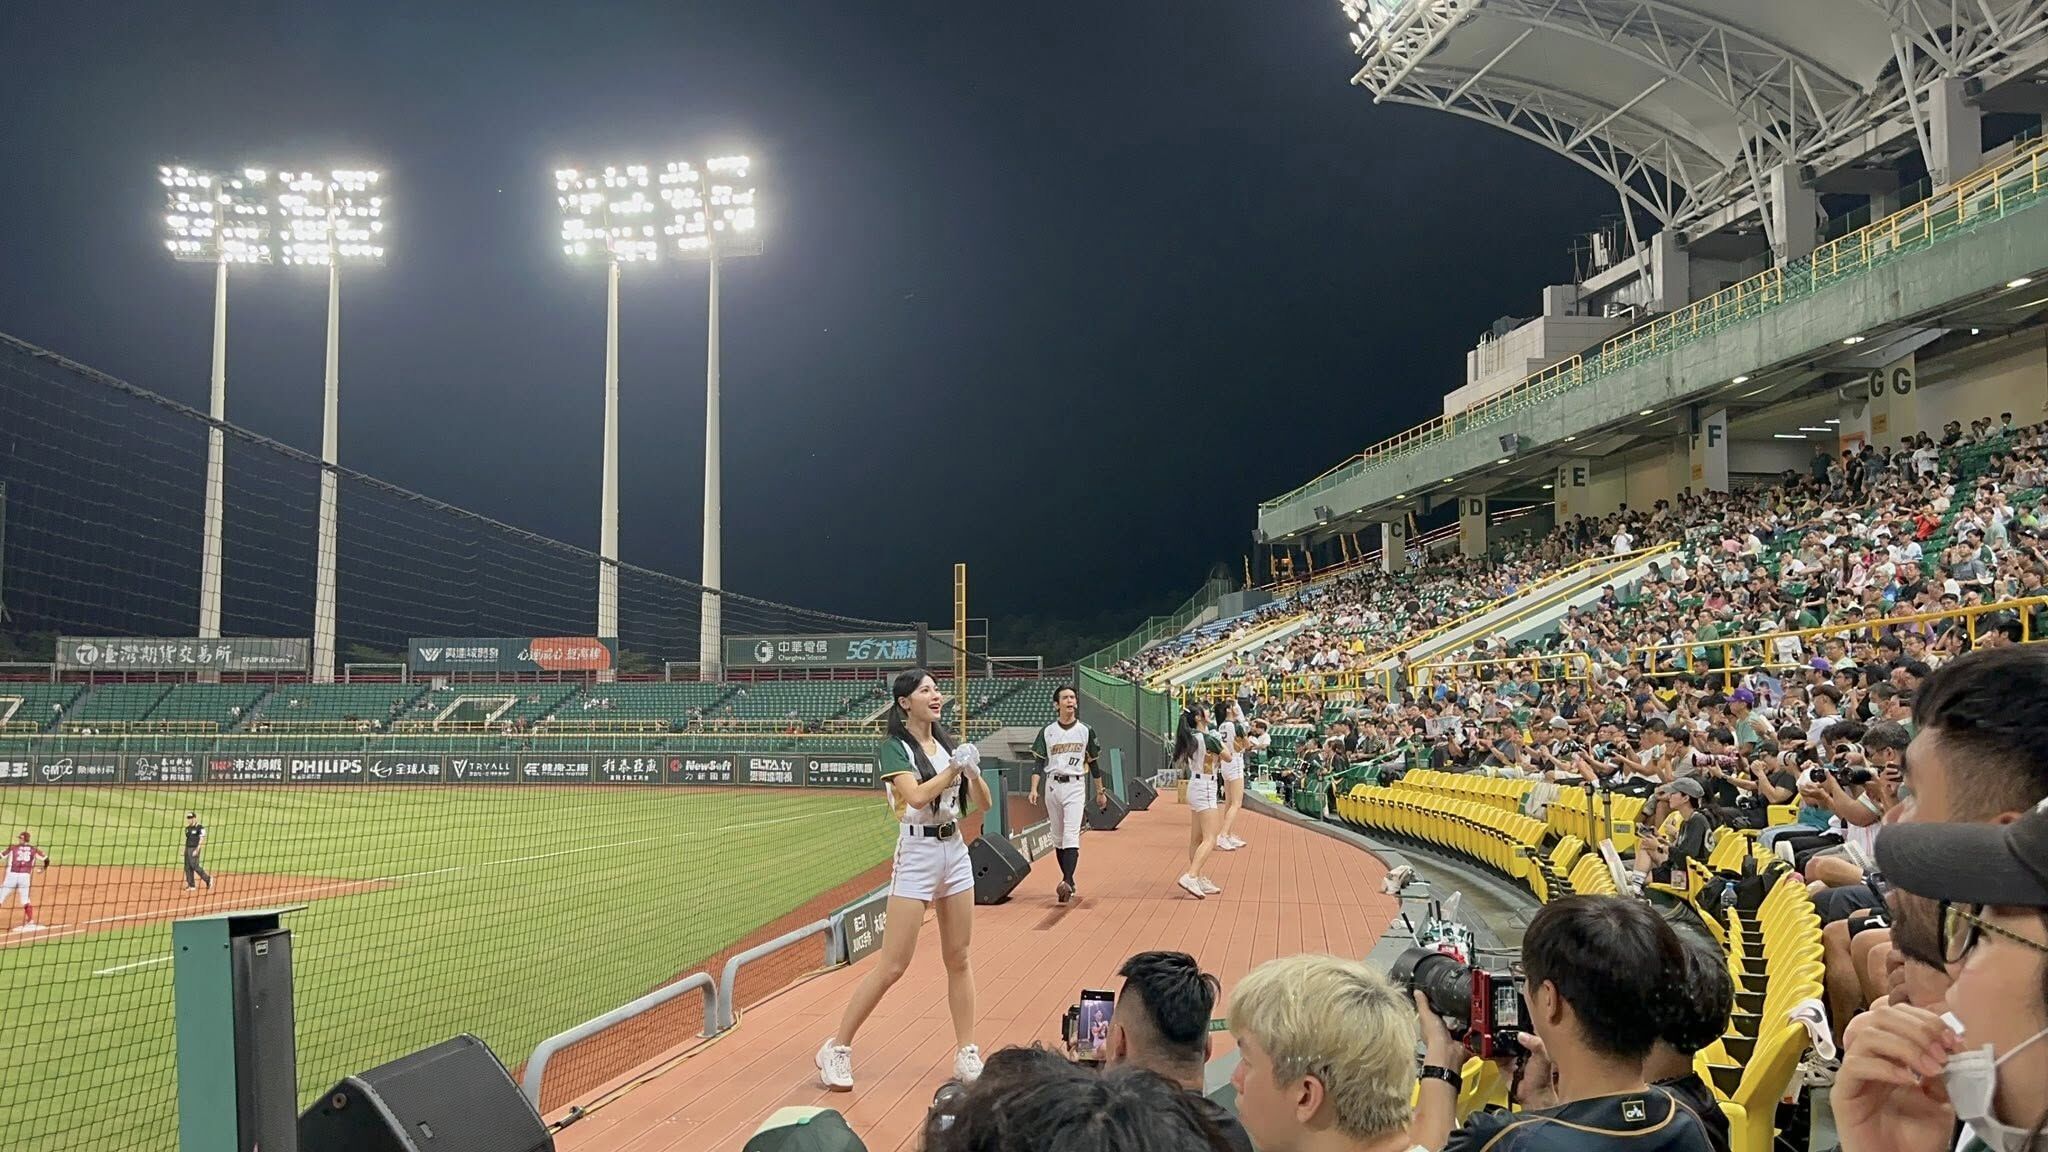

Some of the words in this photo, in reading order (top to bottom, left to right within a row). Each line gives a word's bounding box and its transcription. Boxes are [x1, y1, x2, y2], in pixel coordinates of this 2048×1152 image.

[1871, 367, 1884, 397] G
[1893, 367, 1911, 395] G
[1708, 425, 1722, 447] F
[1560, 469, 1566, 488] E
[1573, 467, 1585, 486] E
[1470, 499, 1483, 516] D
[1391, 522, 1402, 538] C
[101, 643, 232, 664] 臺灣期貨交易所
[778, 640, 828, 654] 中華電信
[291, 759, 363, 774] PHILIPS
[395, 763, 441, 775] 全球人壽
[469, 762, 510, 770] TRYALL
[541, 763, 589, 772] 健身工廠
[685, 759, 732, 771] NewSoft
[750, 758, 793, 771] ELTA.tv
[1069, 757, 1080, 767] 07
